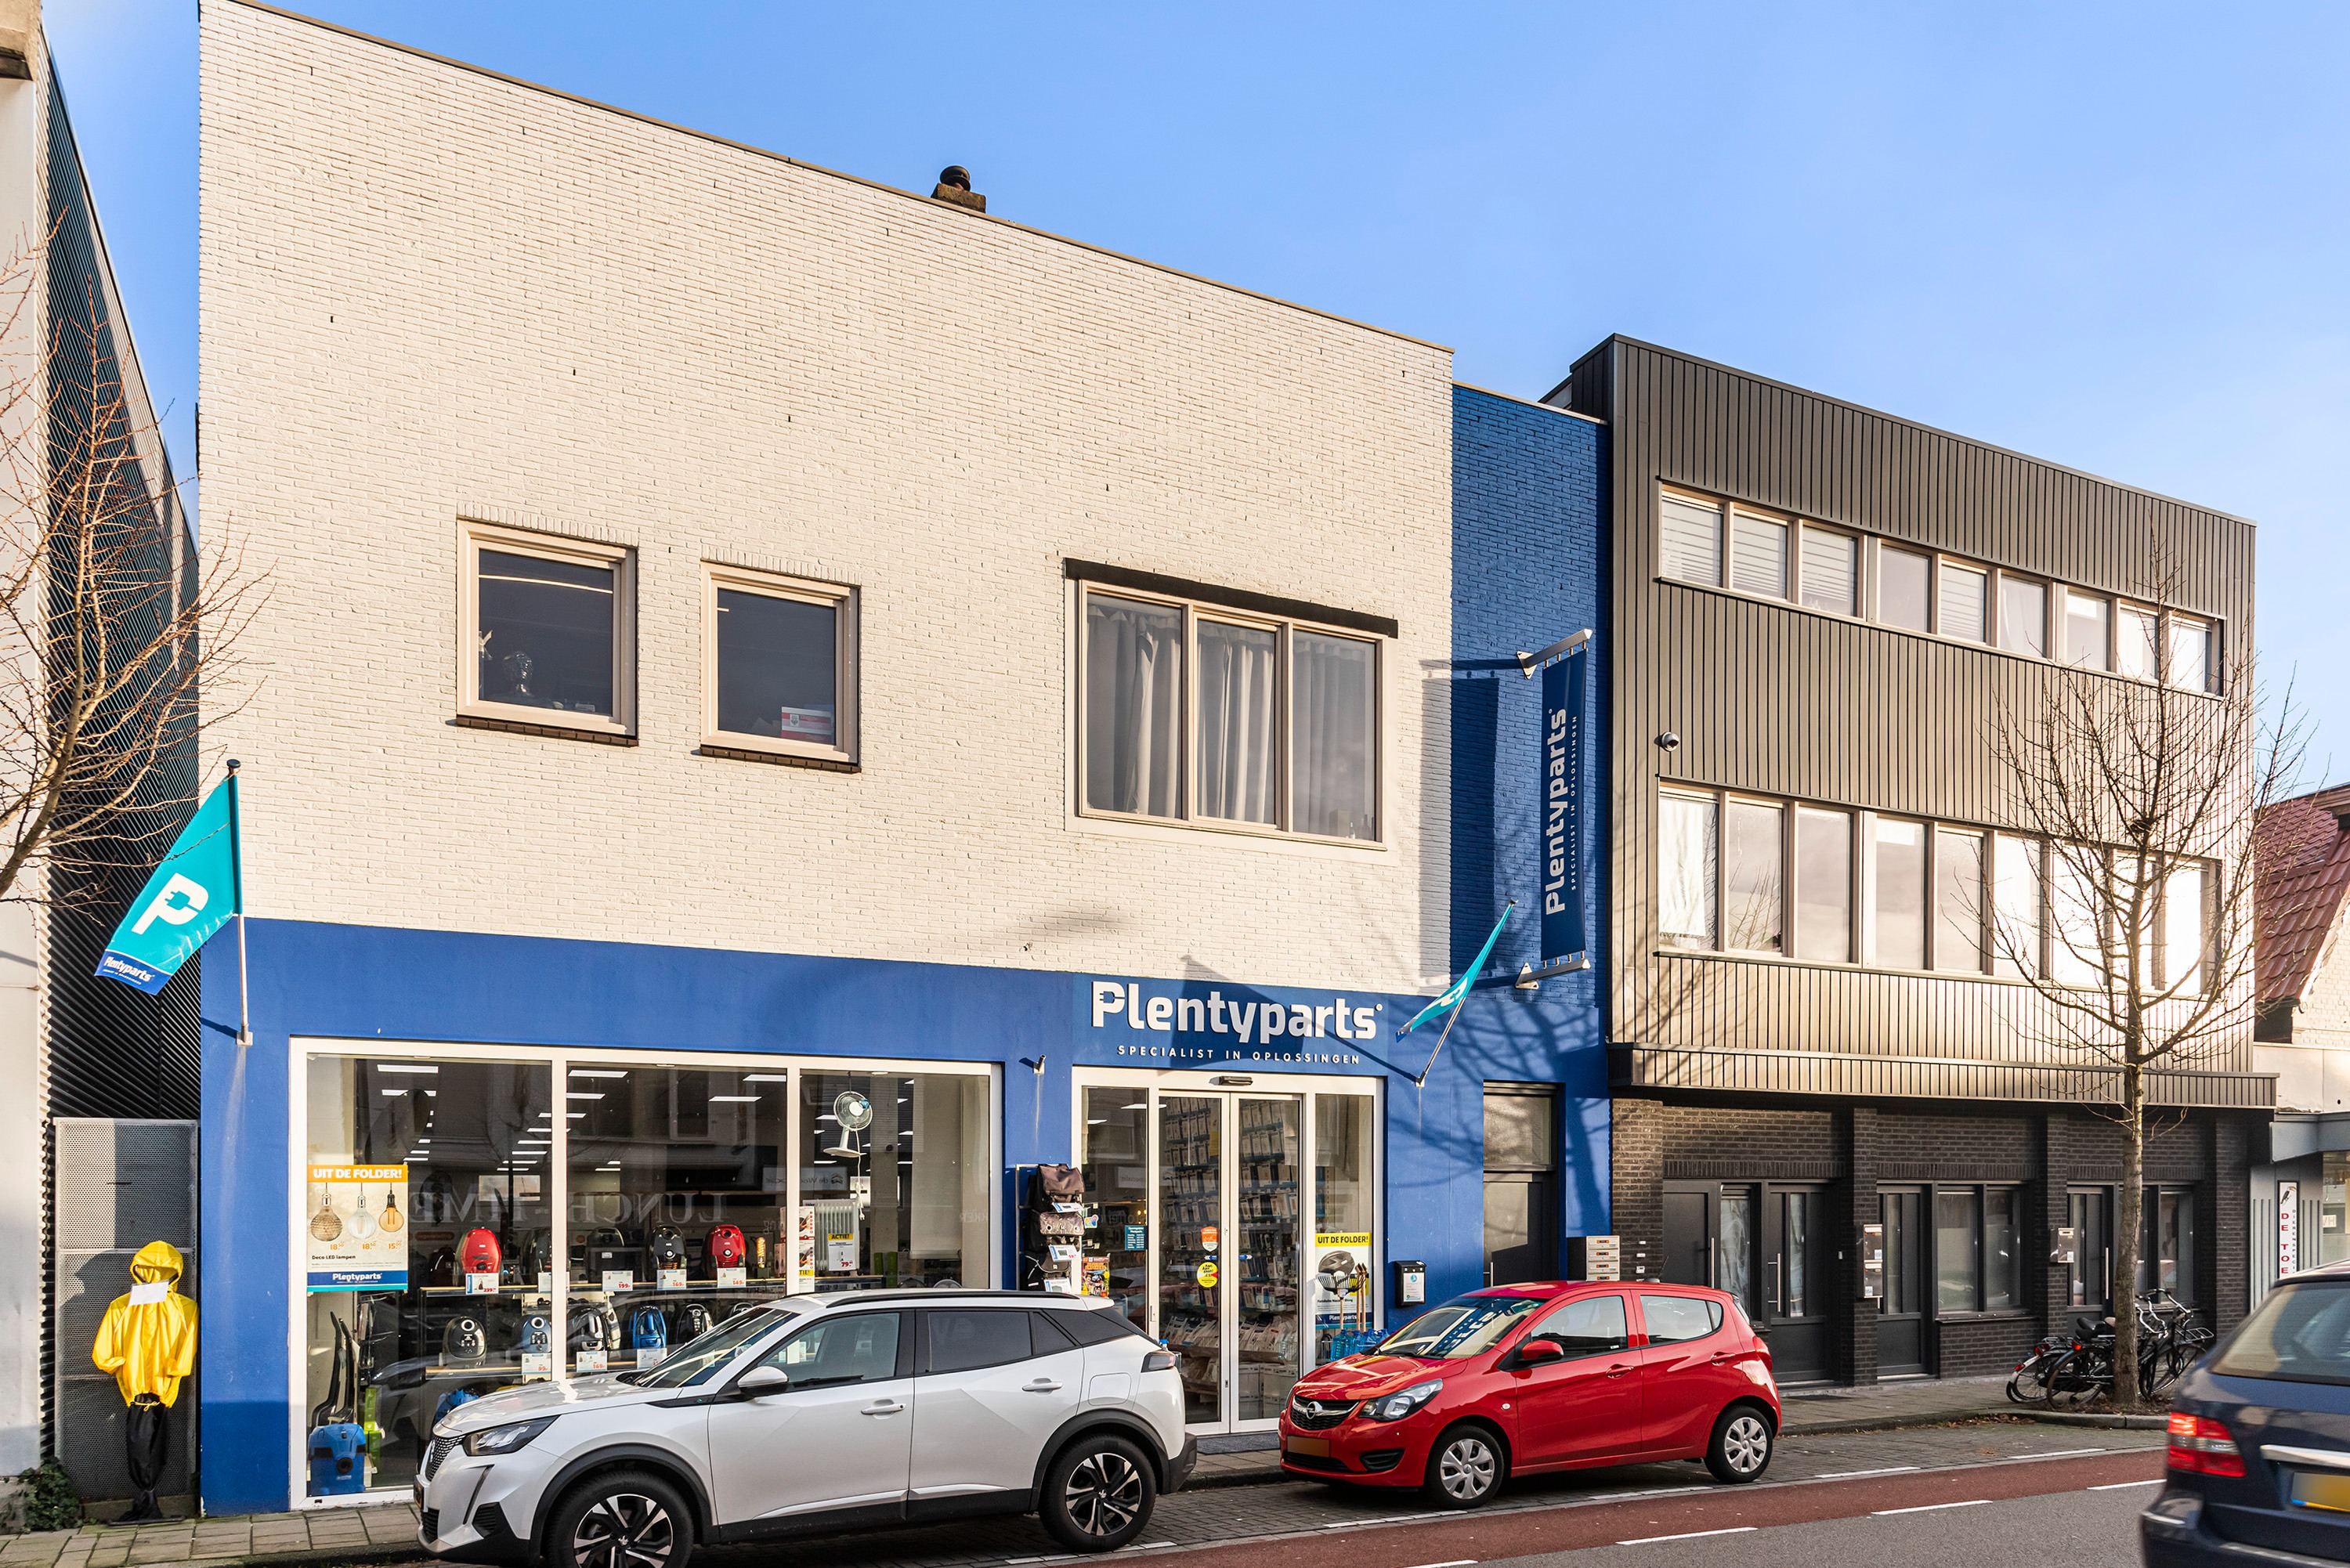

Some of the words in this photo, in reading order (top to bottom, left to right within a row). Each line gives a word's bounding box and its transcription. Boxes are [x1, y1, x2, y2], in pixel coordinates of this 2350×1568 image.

[1571, 804, 1575, 816] IN
[1117, 1045, 1214, 1059] SPECIALIST
[1225, 1050, 1241, 1060] IN
[1253, 1052, 1360, 1064] OPLOSSINGEN
[313, 1169, 333, 1179] UIT
[335, 1169, 351, 1179] DE
[353, 1169, 402, 1179] FOLDER!
